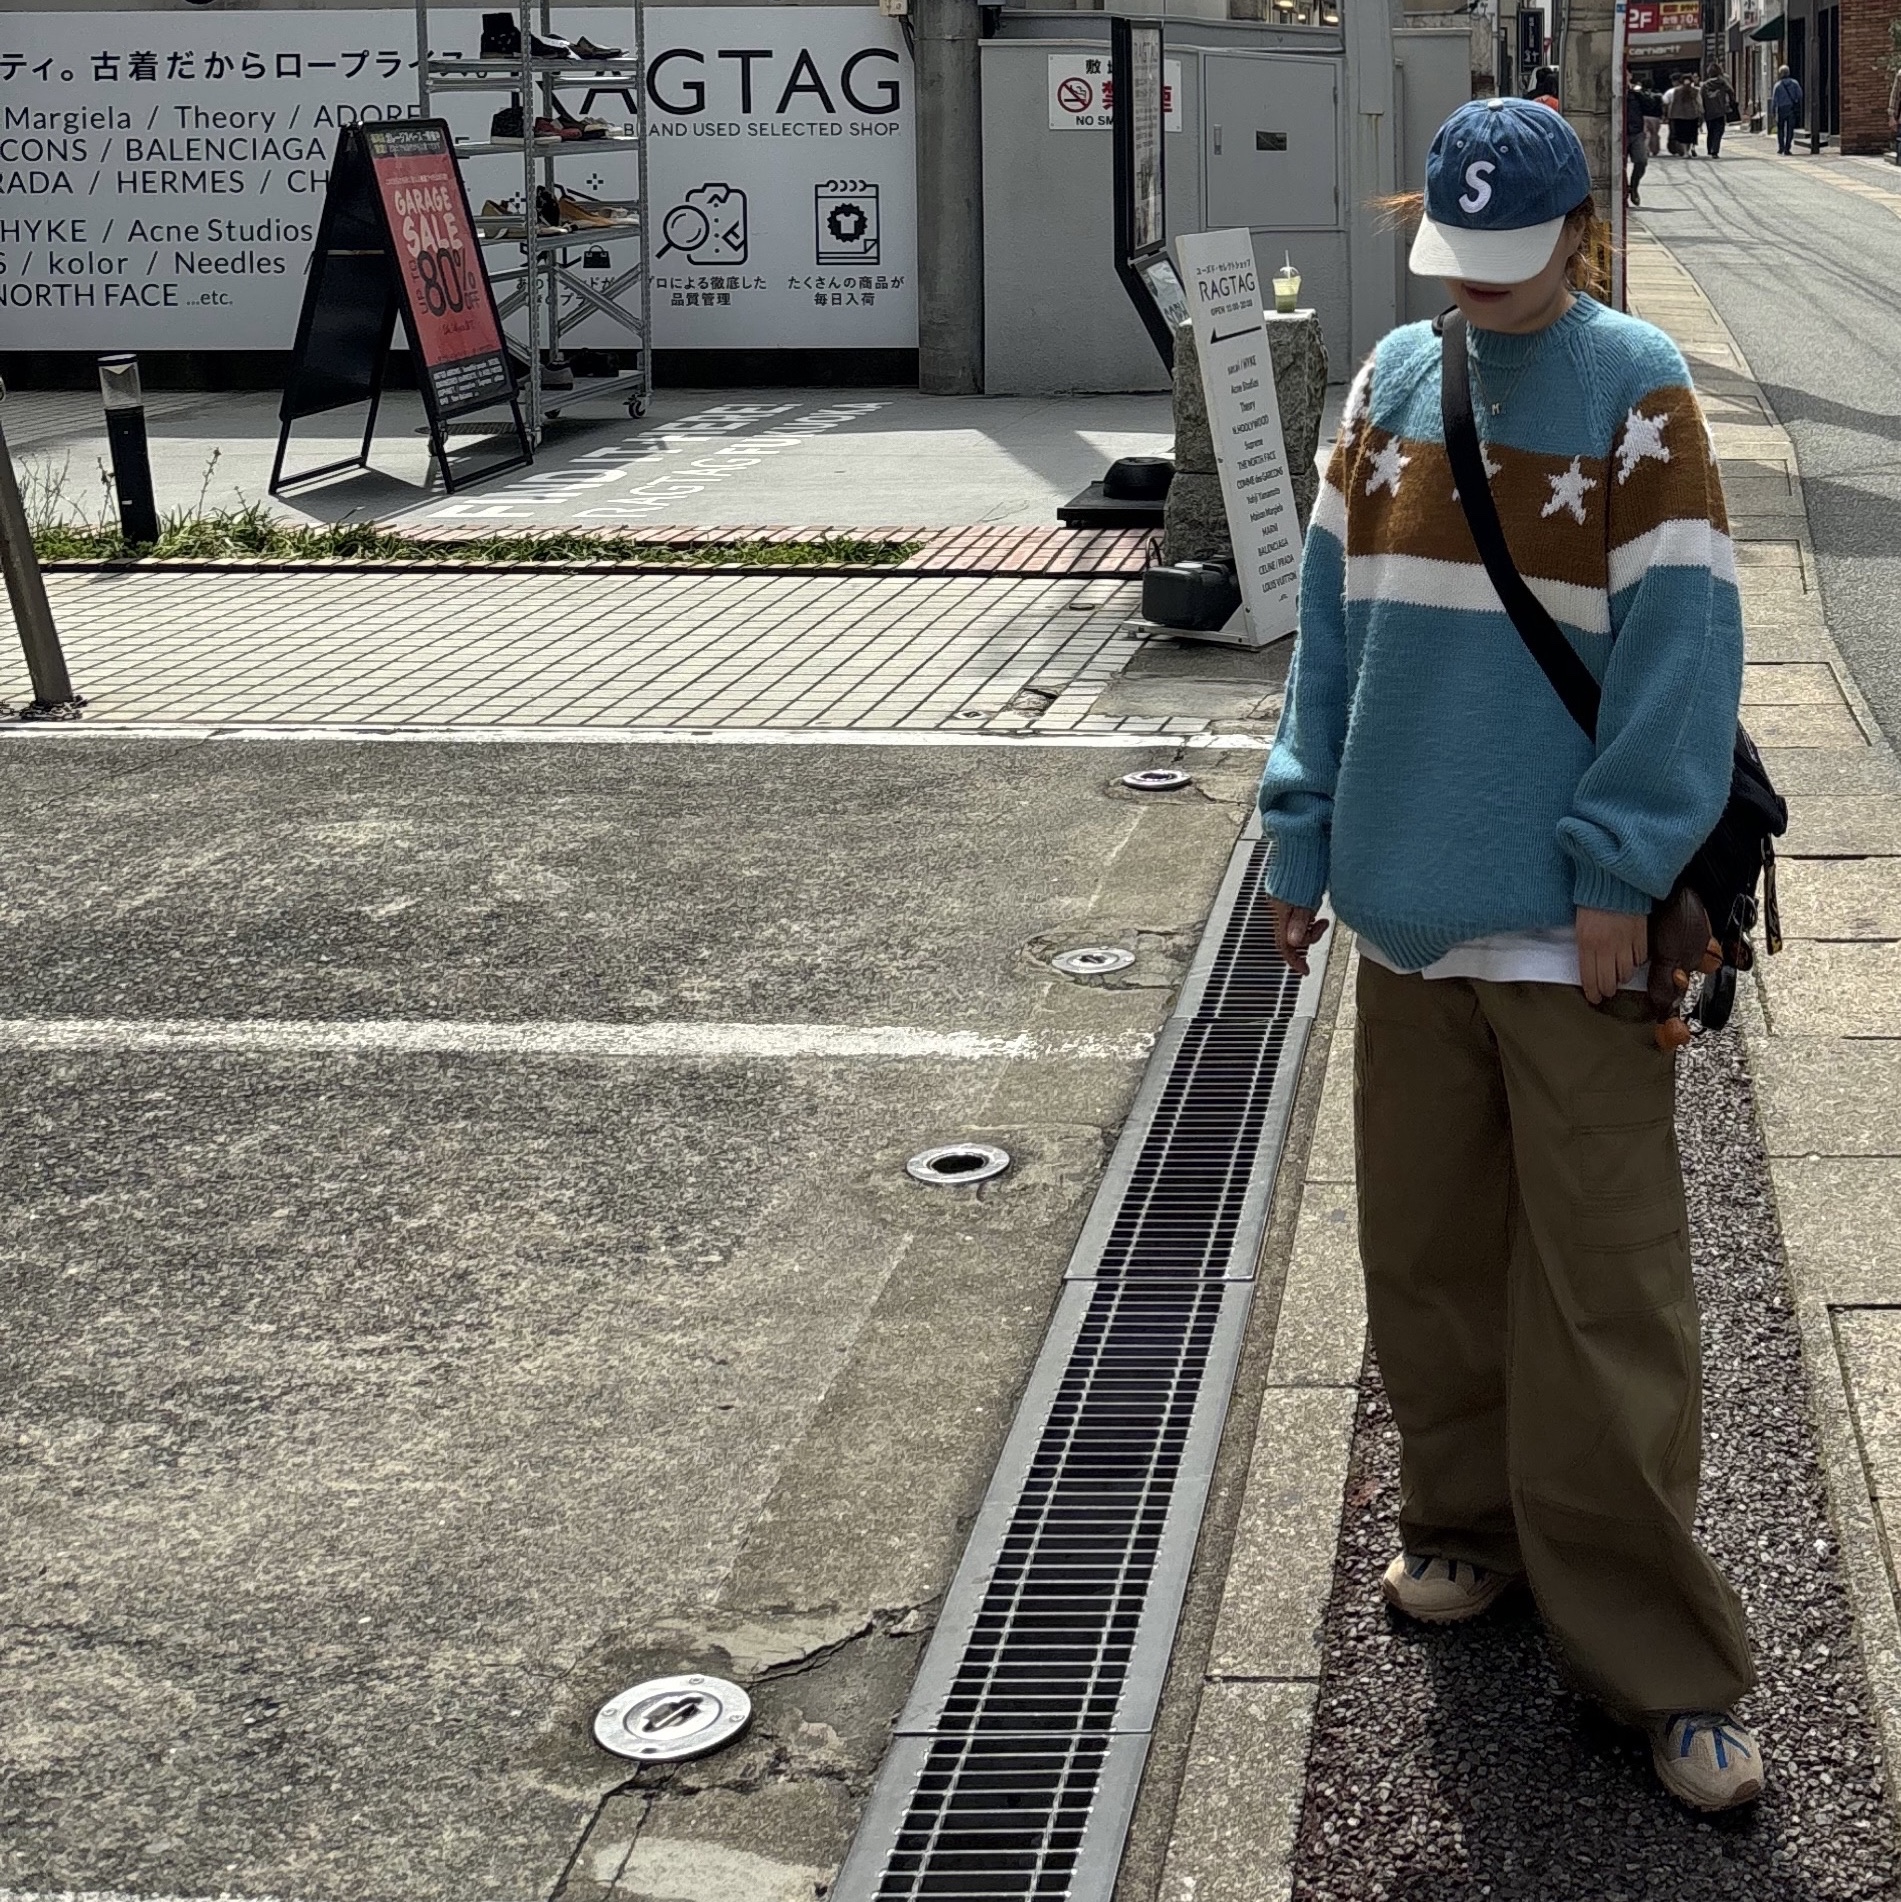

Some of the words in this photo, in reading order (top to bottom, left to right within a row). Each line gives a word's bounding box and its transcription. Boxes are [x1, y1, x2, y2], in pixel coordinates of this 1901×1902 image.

[1628, 8, 1653, 29] 2F
[1628, 44, 1682, 56] carhartt
[0, 50, 487, 81] ティ。古着だからロープラ
[5, 105, 131, 134] Margiela
[174, 105, 276, 134] Theory
[625, 123, 688, 137] BAND
[692, 123, 741, 137] USED
[747, 123, 843, 137] SELECTED
[849, 123, 900, 137] SHOP
[1075, 115, 1094, 126] NO
[1097, 115, 1113, 126] SM
[0, 138, 88, 162] CONS
[126, 138, 327, 162] BALENCIAGA
[0, 170, 74, 194] ADA
[117, 170, 244, 194] HERMES
[287, 169, 330, 193] CH
[1458, 160, 1497, 214] S
[394, 185, 453, 216] GARAGE
[0, 219, 87, 243] HYKE
[127, 219, 199, 243] Acne
[207, 217, 313, 242] Studios
[402, 212, 464, 258] SALE
[49, 251, 129, 275] kolor
[175, 251, 286, 275] Needles
[417, 247, 476, 317] 80%
[787, 275, 905, 290] たくさんの商品が
[1198, 272, 1256, 302] RAGTAG
[104, 283, 179, 307] FACE
[671, 292, 731, 307] 品質管理
[813, 292, 875, 307] 毎日入荷
[572, 457, 762, 518] RAGTAG
